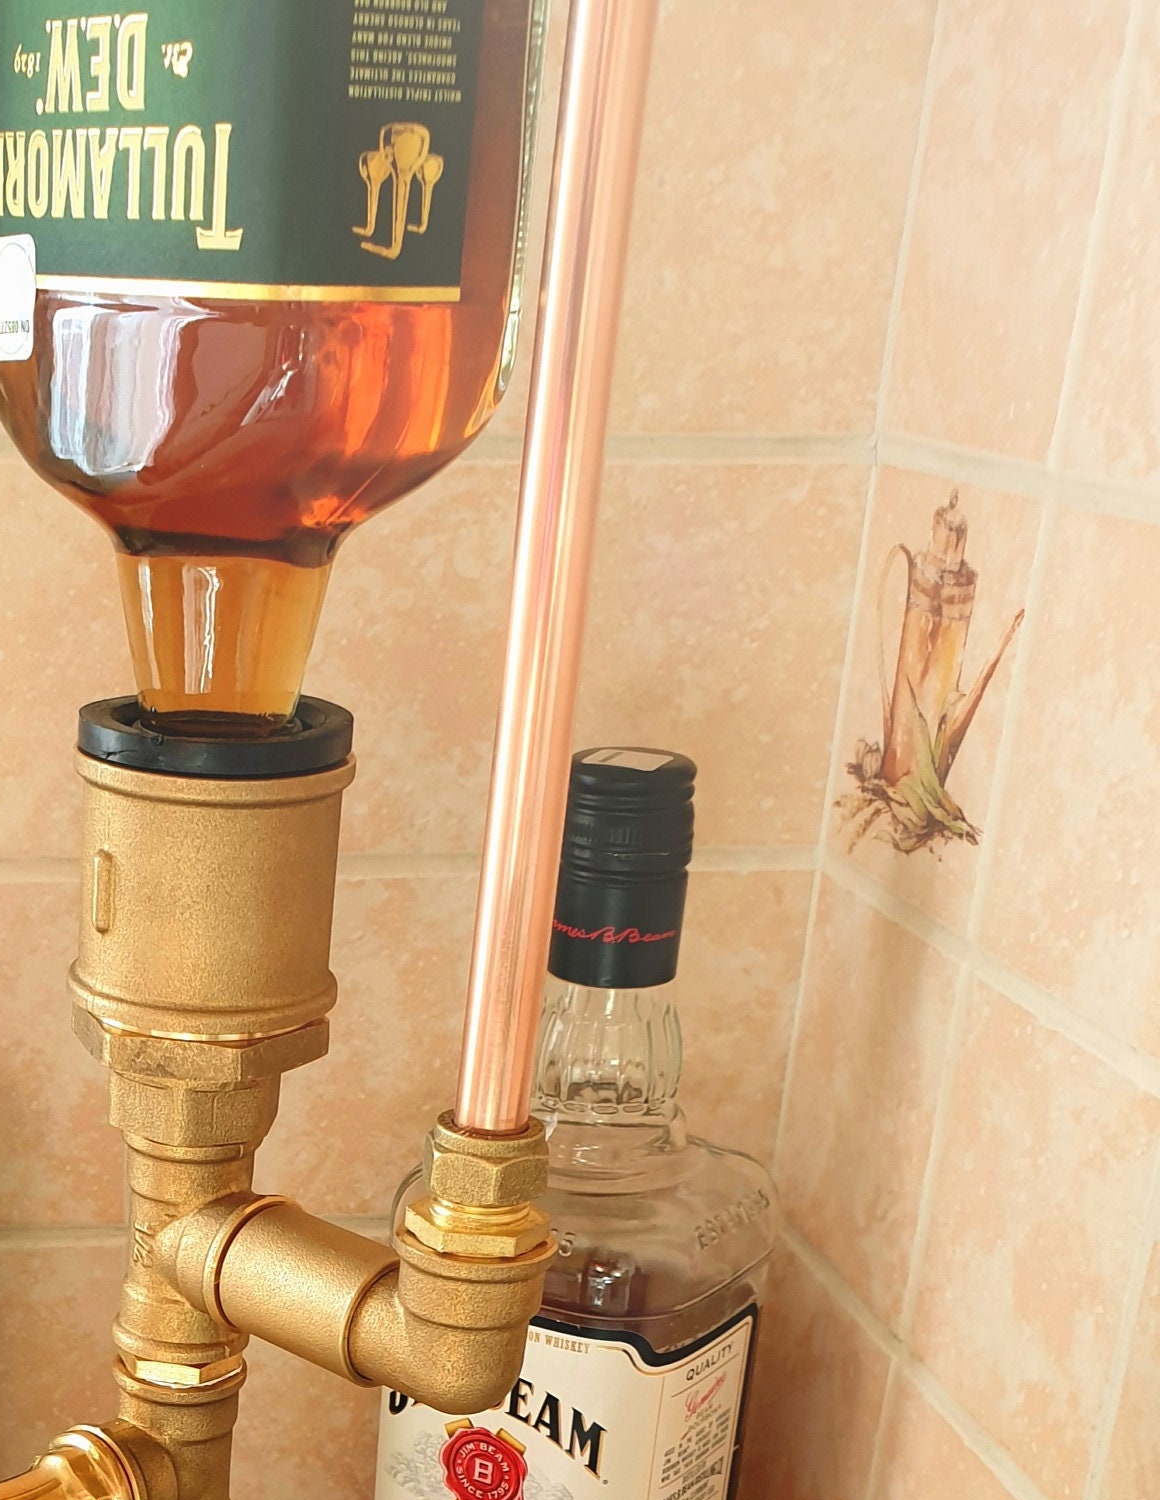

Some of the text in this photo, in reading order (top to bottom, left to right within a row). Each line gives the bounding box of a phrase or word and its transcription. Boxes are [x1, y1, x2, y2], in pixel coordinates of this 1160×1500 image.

[13, 44, 41, 78] 1829
[545, 1335, 590, 1354] WHISKEY
[685, 1343, 733, 1381] QUALITY
[502, 1377, 608, 1480] EAM
[460, 1443, 510, 1472] JIM BEAM
[456, 1466, 509, 1500] SINCE 1795
